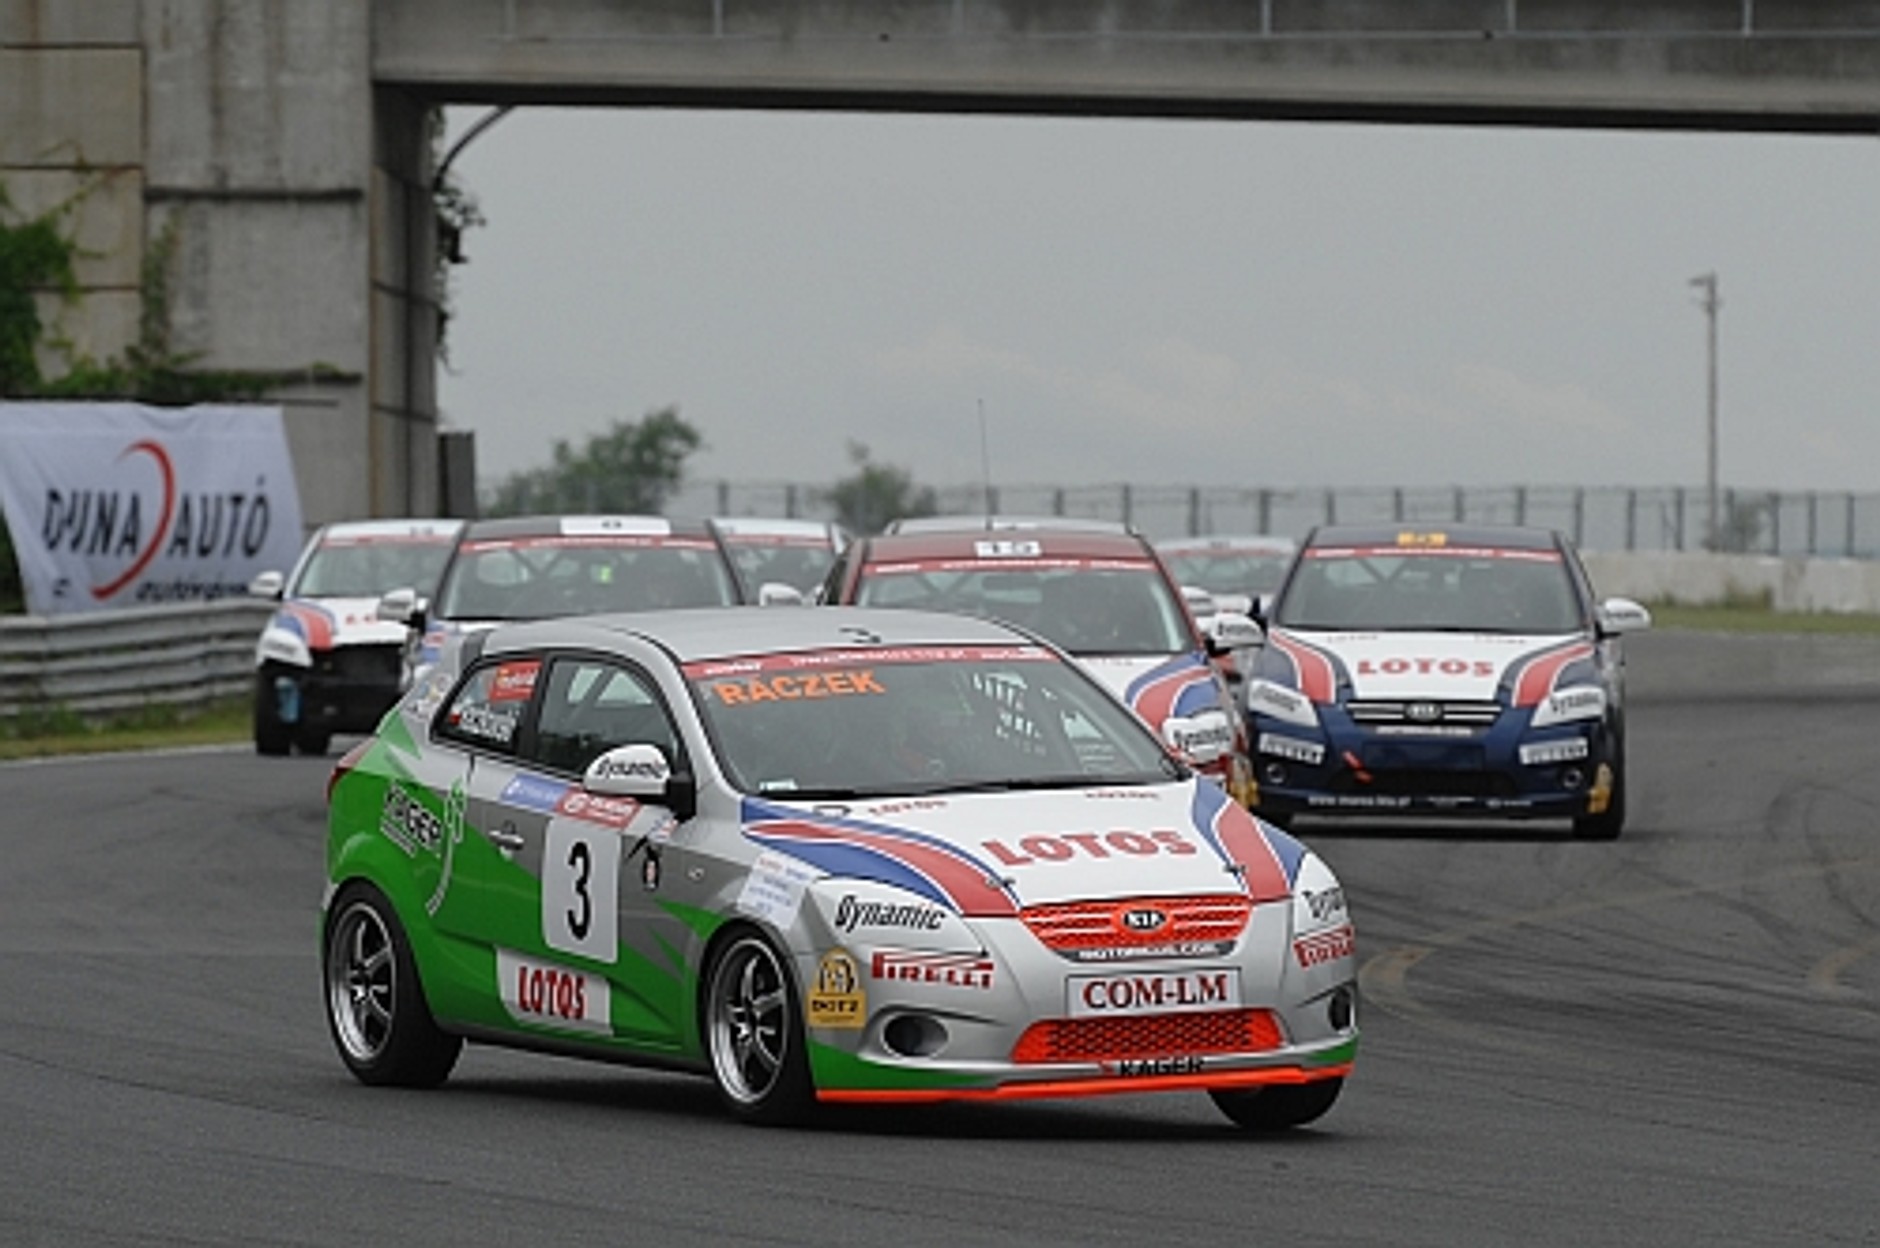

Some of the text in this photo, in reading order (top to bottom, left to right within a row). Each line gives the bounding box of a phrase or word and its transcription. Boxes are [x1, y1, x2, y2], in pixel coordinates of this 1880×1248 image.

[42, 474, 270, 558] DUNA AUTÓ
[1357, 659, 1494, 677] LOTOS
[981, 831, 1197, 867] LOTOS
[567, 841, 591, 941] 3
[835, 895, 947, 933] Dynamic
[871, 951, 995, 989] PIRELLI
[519, 966, 587, 1021] LOTOS
[1083, 973, 1228, 1009] COM-LM
